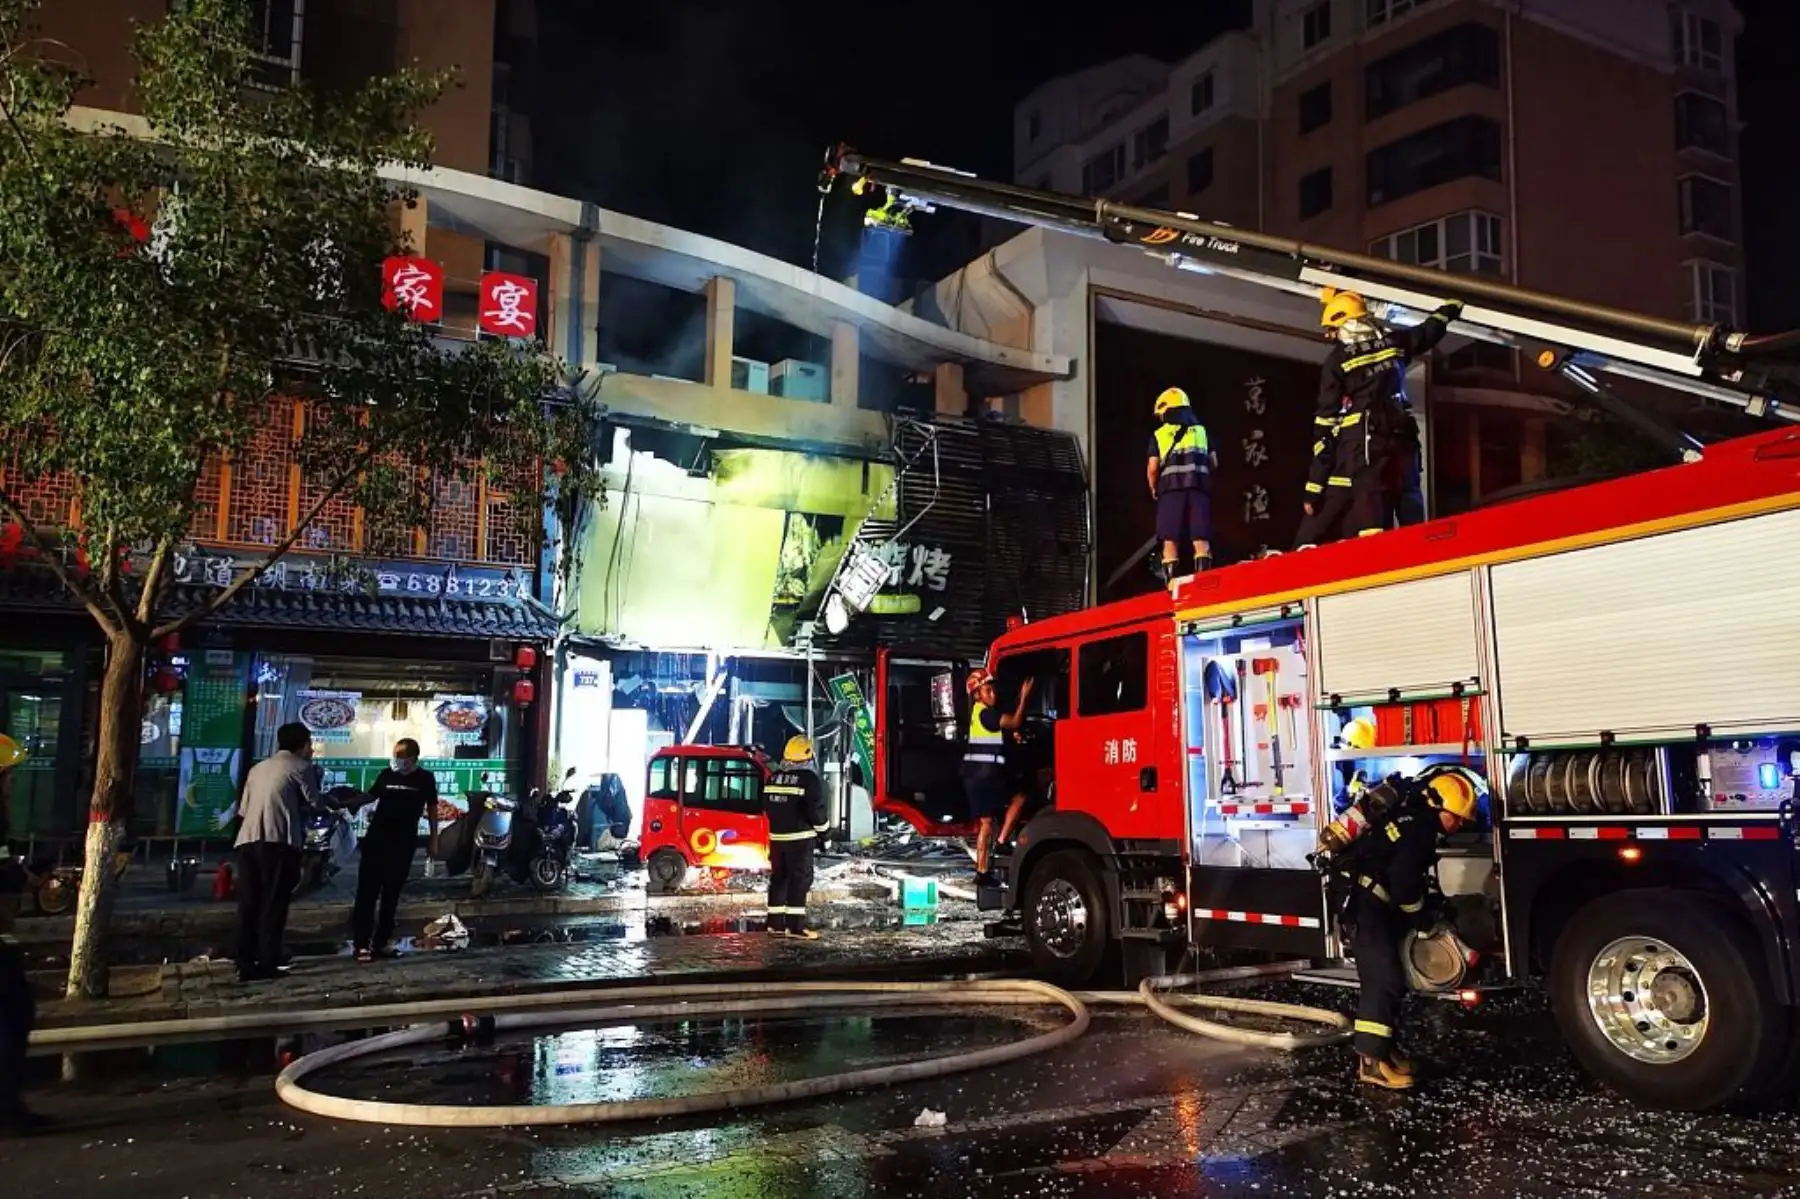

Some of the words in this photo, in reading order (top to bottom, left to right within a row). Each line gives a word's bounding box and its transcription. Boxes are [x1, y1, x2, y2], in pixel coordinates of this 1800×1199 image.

[1181, 232, 1205, 246] Fire
[1207, 236, 1240, 254] Truck
[393, 263, 533, 332] 家宴
[1104, 737, 1137, 765] 消防
